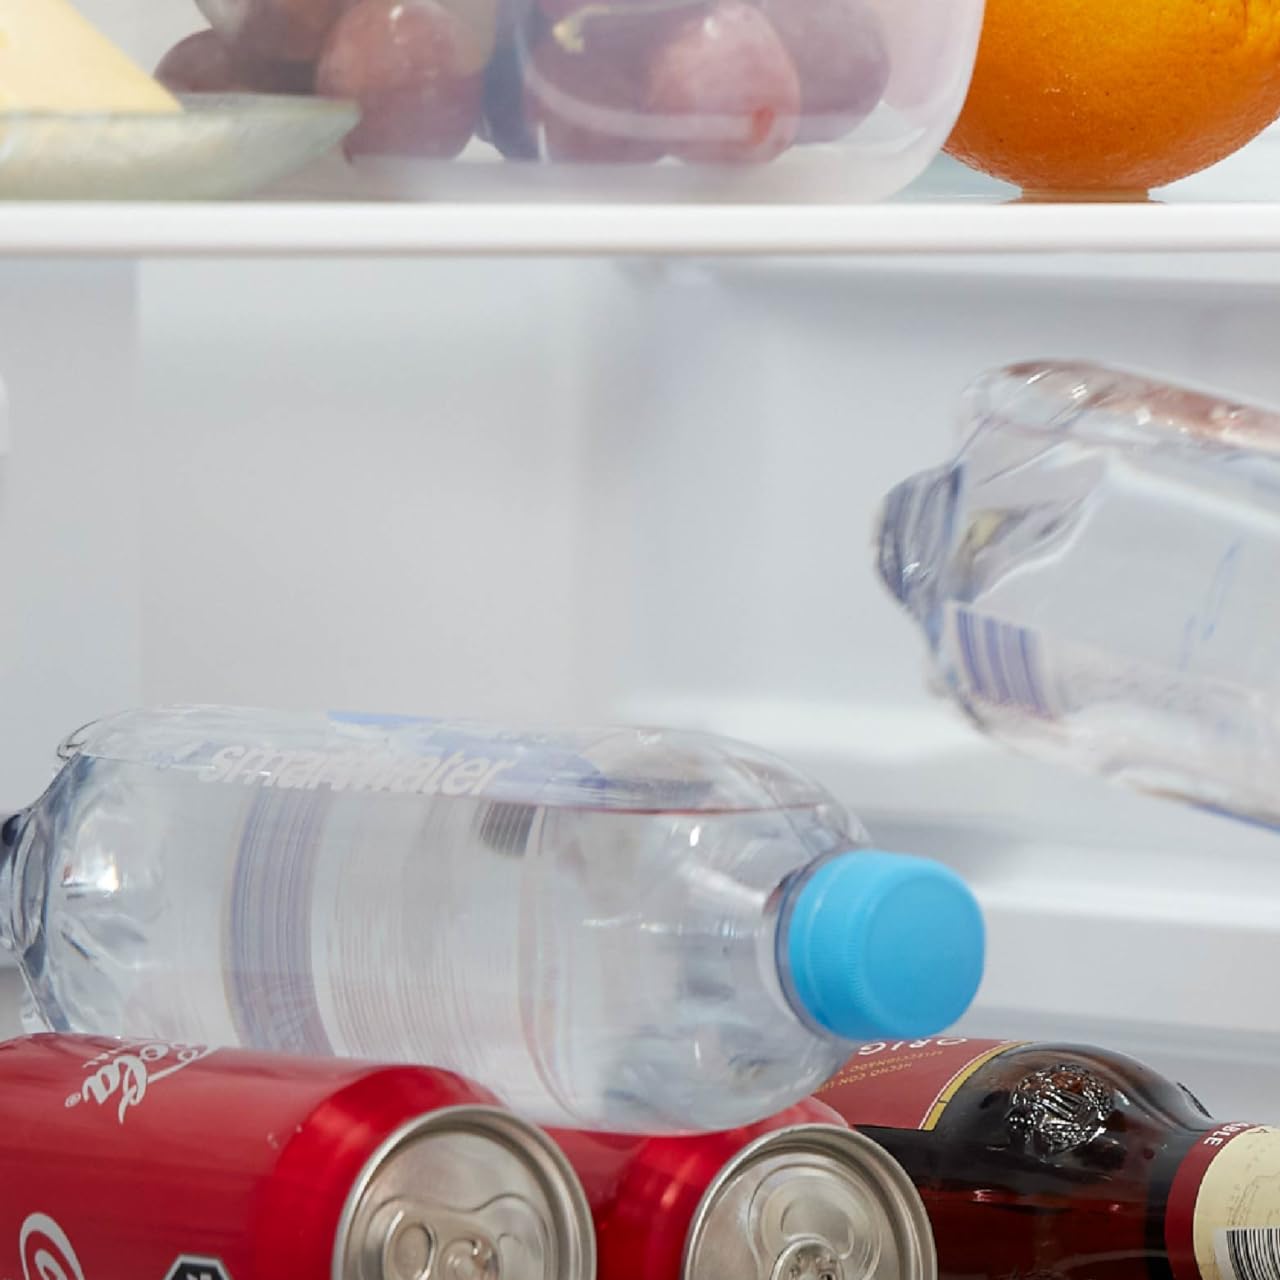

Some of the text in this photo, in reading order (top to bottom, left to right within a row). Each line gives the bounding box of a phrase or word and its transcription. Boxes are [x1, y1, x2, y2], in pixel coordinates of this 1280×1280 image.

[858, 1038, 967, 1055] ORIG
[870, 1062, 912, 1077] HECHO
[838, 1073, 866, 1087] CON
